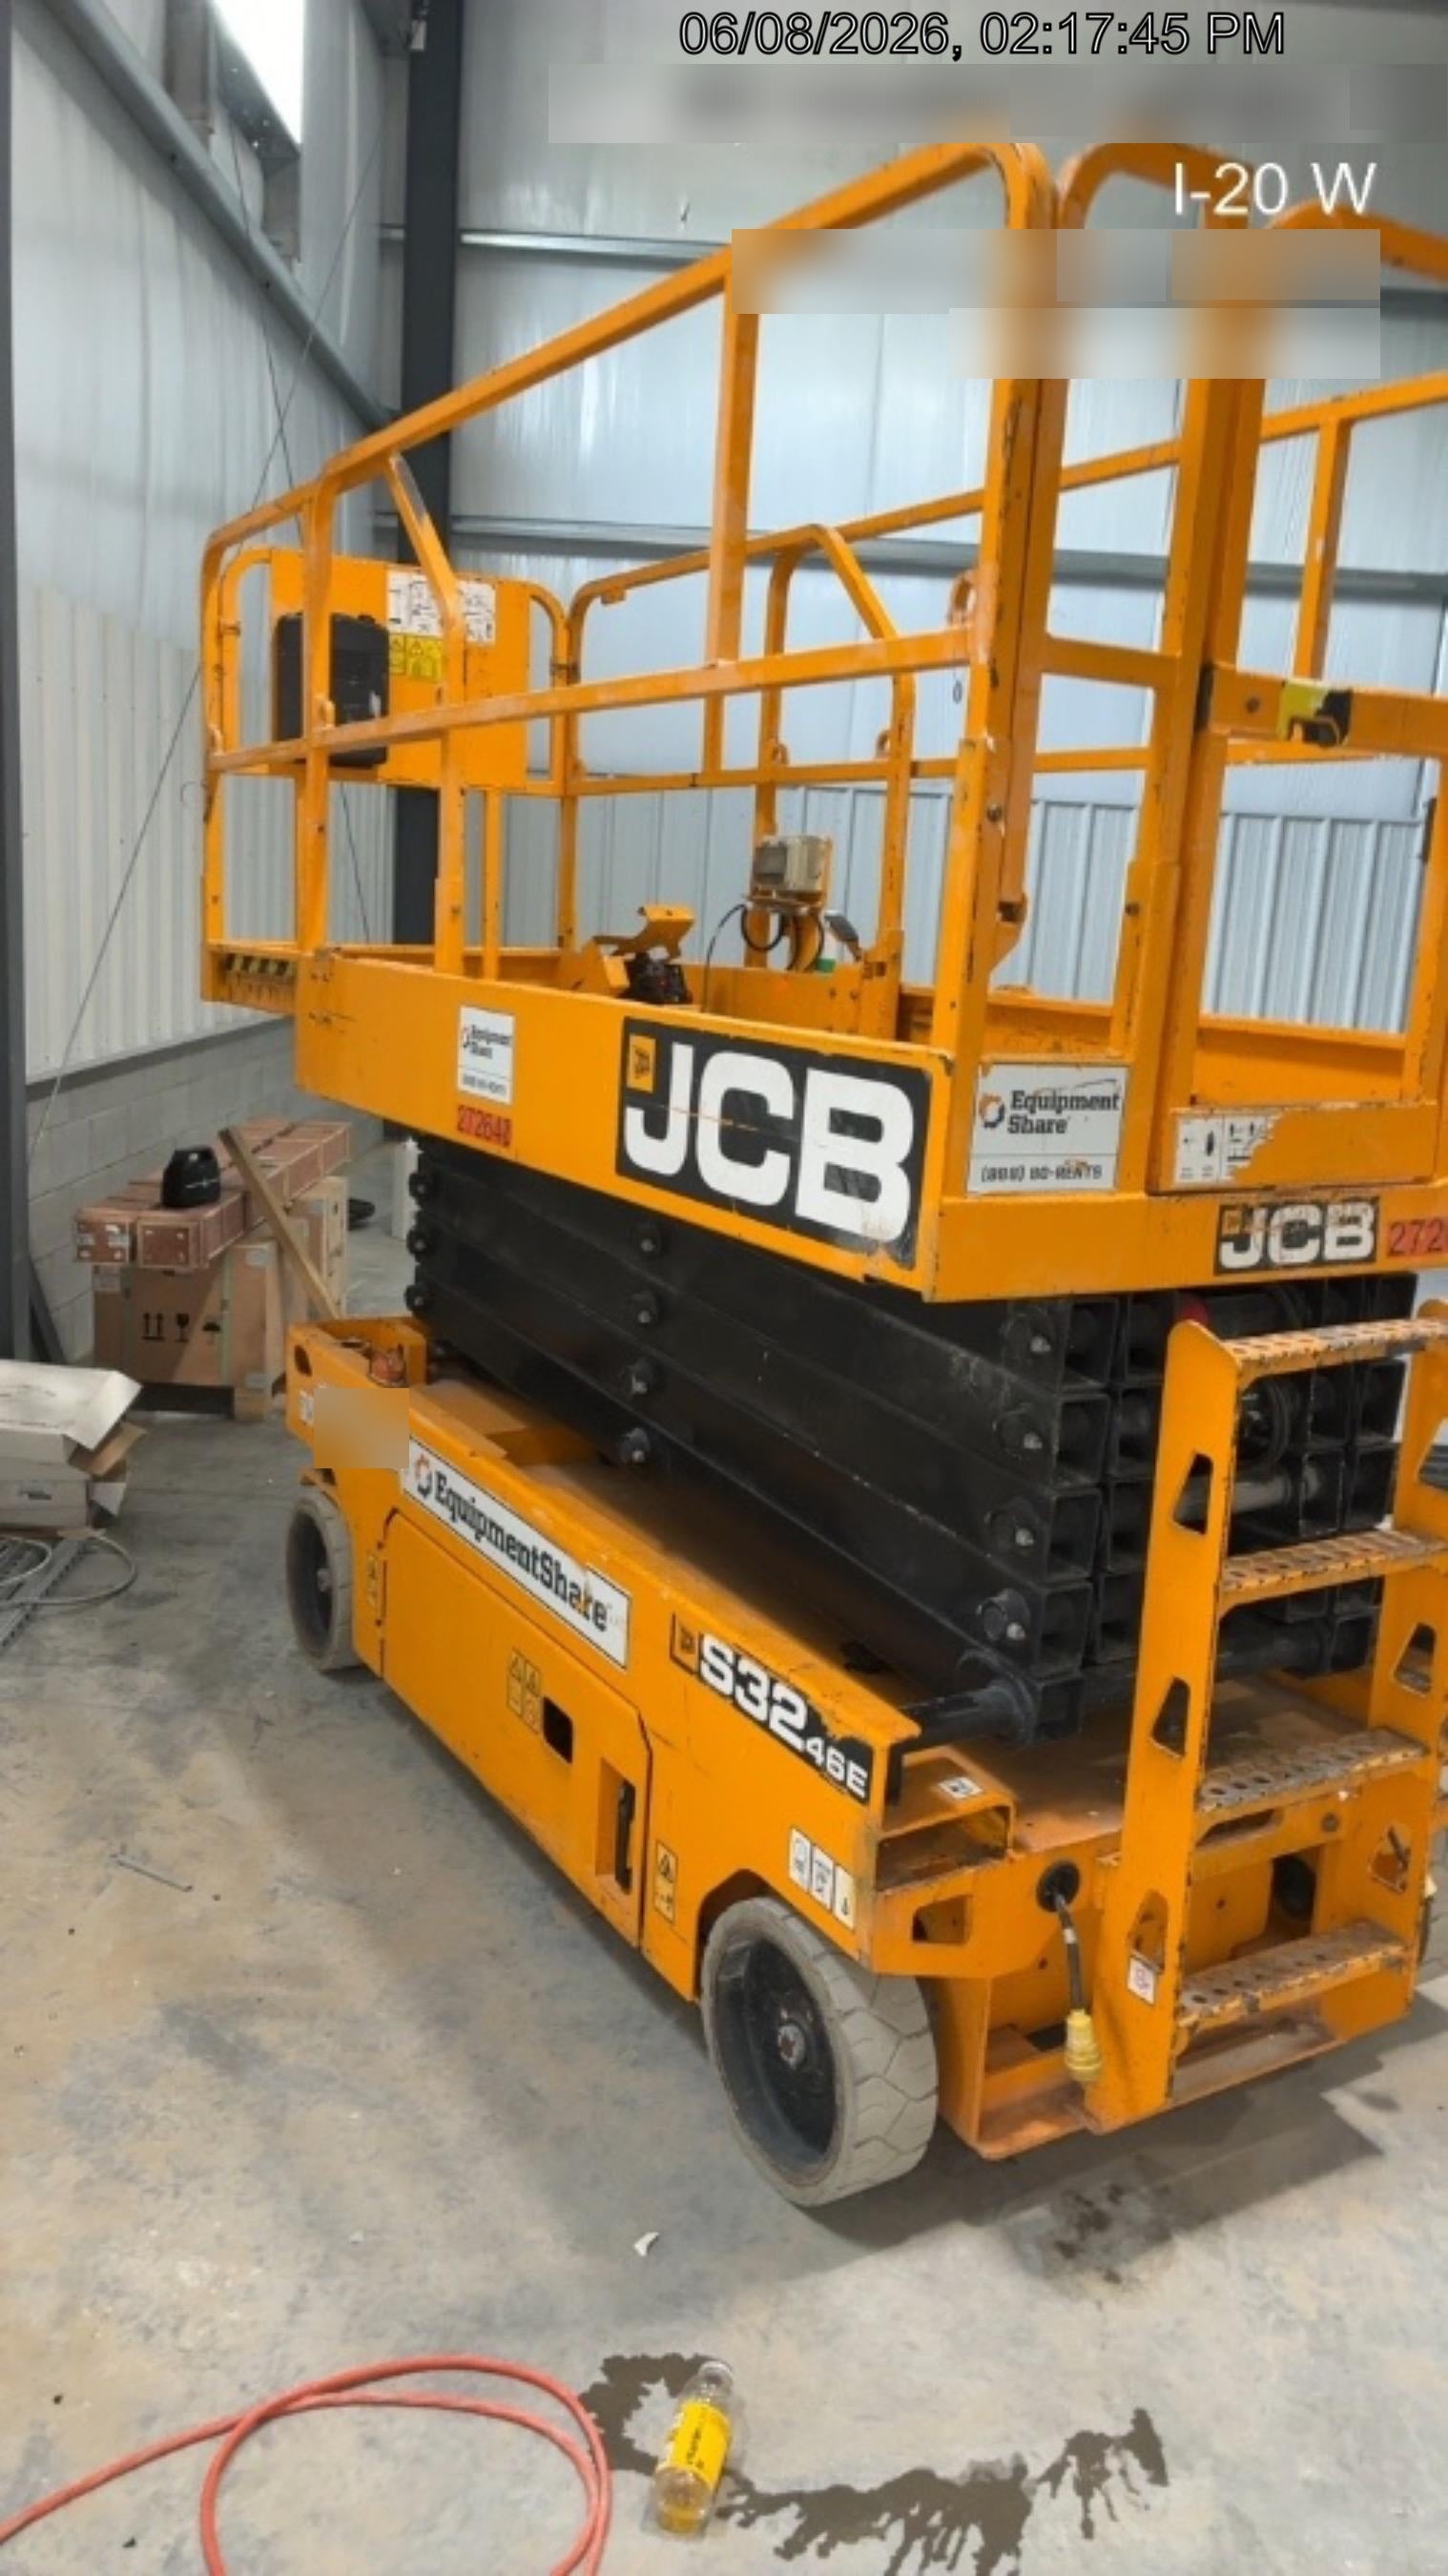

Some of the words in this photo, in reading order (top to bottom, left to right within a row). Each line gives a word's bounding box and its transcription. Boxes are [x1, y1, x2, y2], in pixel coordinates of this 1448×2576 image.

[1007, 1114, 1067, 1134] Share
[1010, 1089, 1120, 1114] Equipment
[624, 1041, 914, 1241] JCB
[1219, 1200, 1375, 1270] JCB
[1387, 1217, 1448, 1258] 272
[435, 1471, 609, 1632] EquipmentShare
